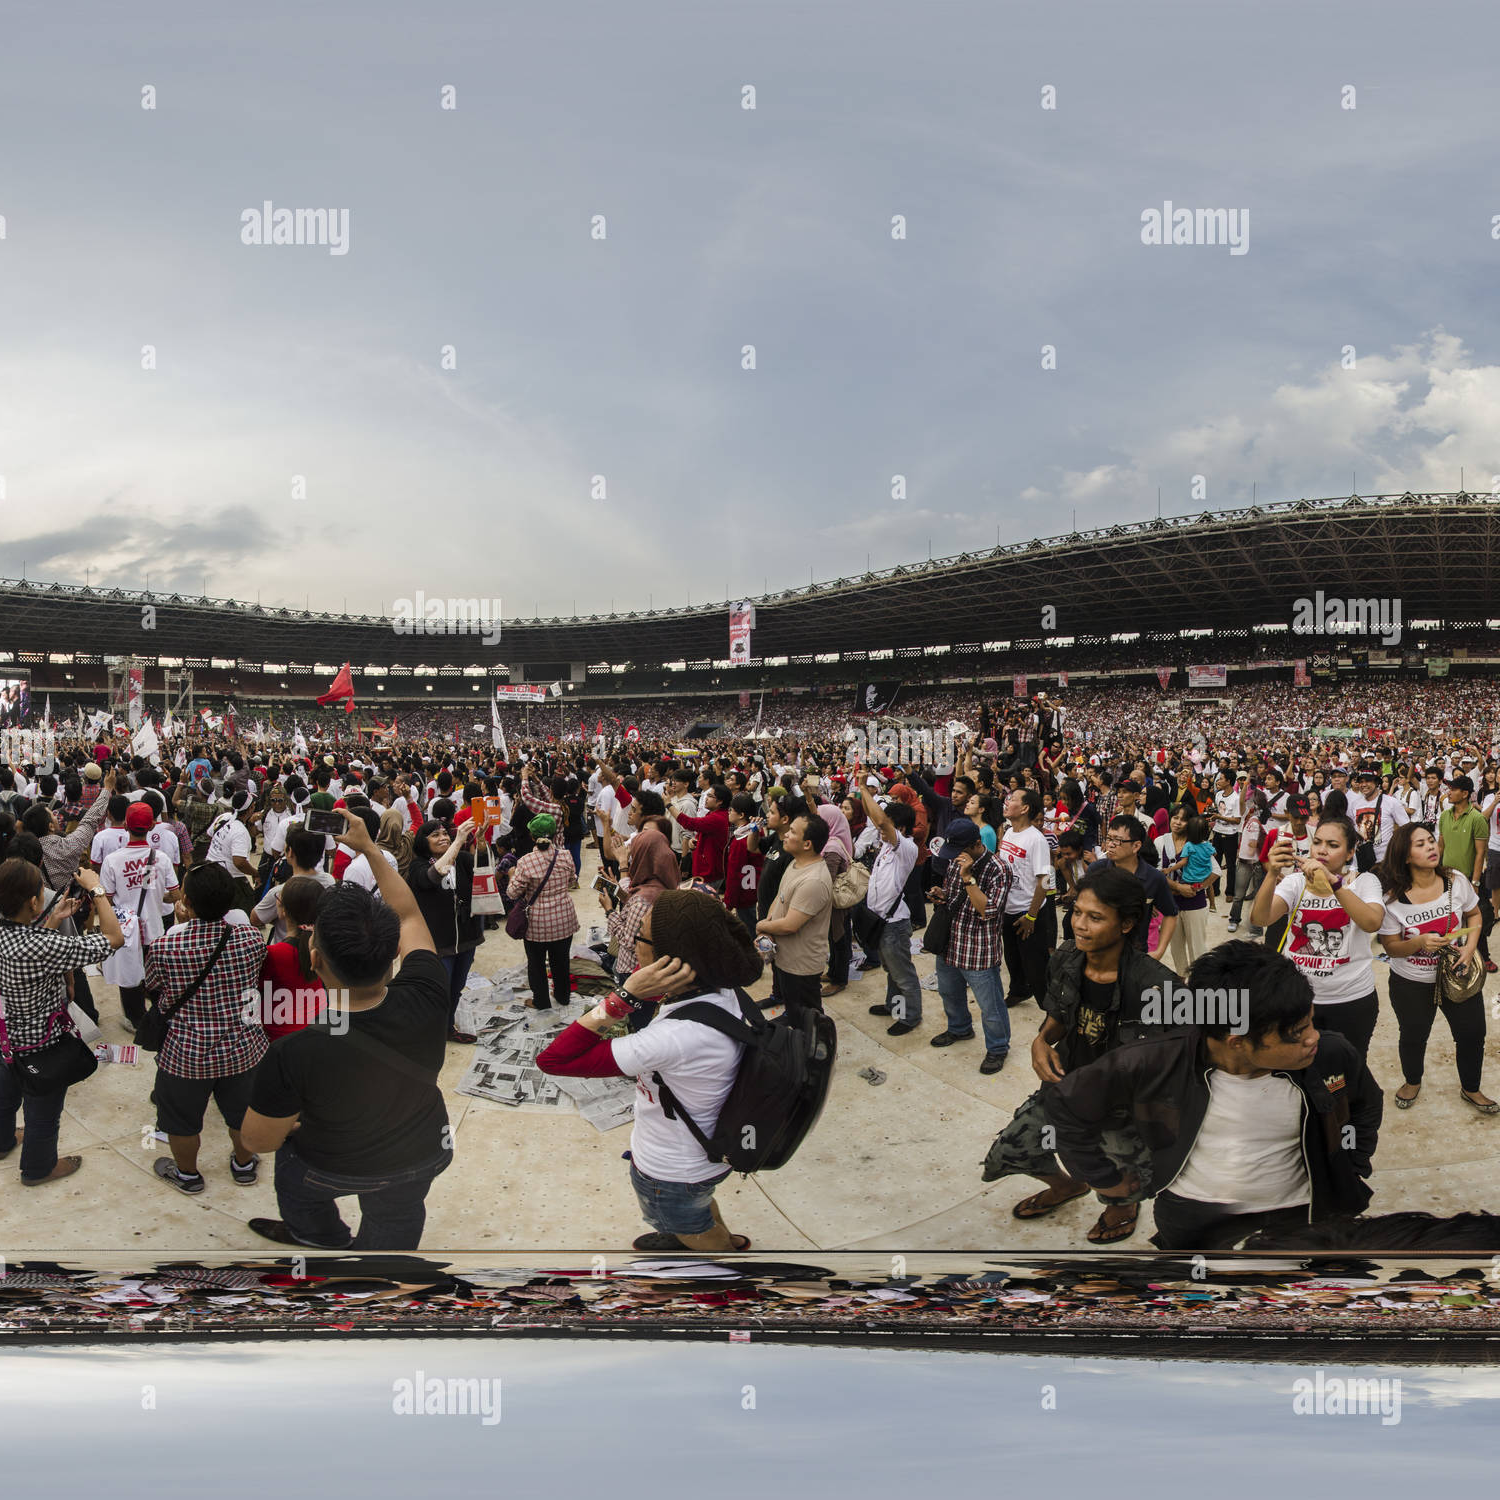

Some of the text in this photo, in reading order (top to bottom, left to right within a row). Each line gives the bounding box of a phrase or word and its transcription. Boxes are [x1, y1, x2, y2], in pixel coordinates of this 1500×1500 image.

[737, 602, 743, 611] 2
[1301, 898, 1343, 909] OBLO
[1314, 969, 1334, 977] KITA
